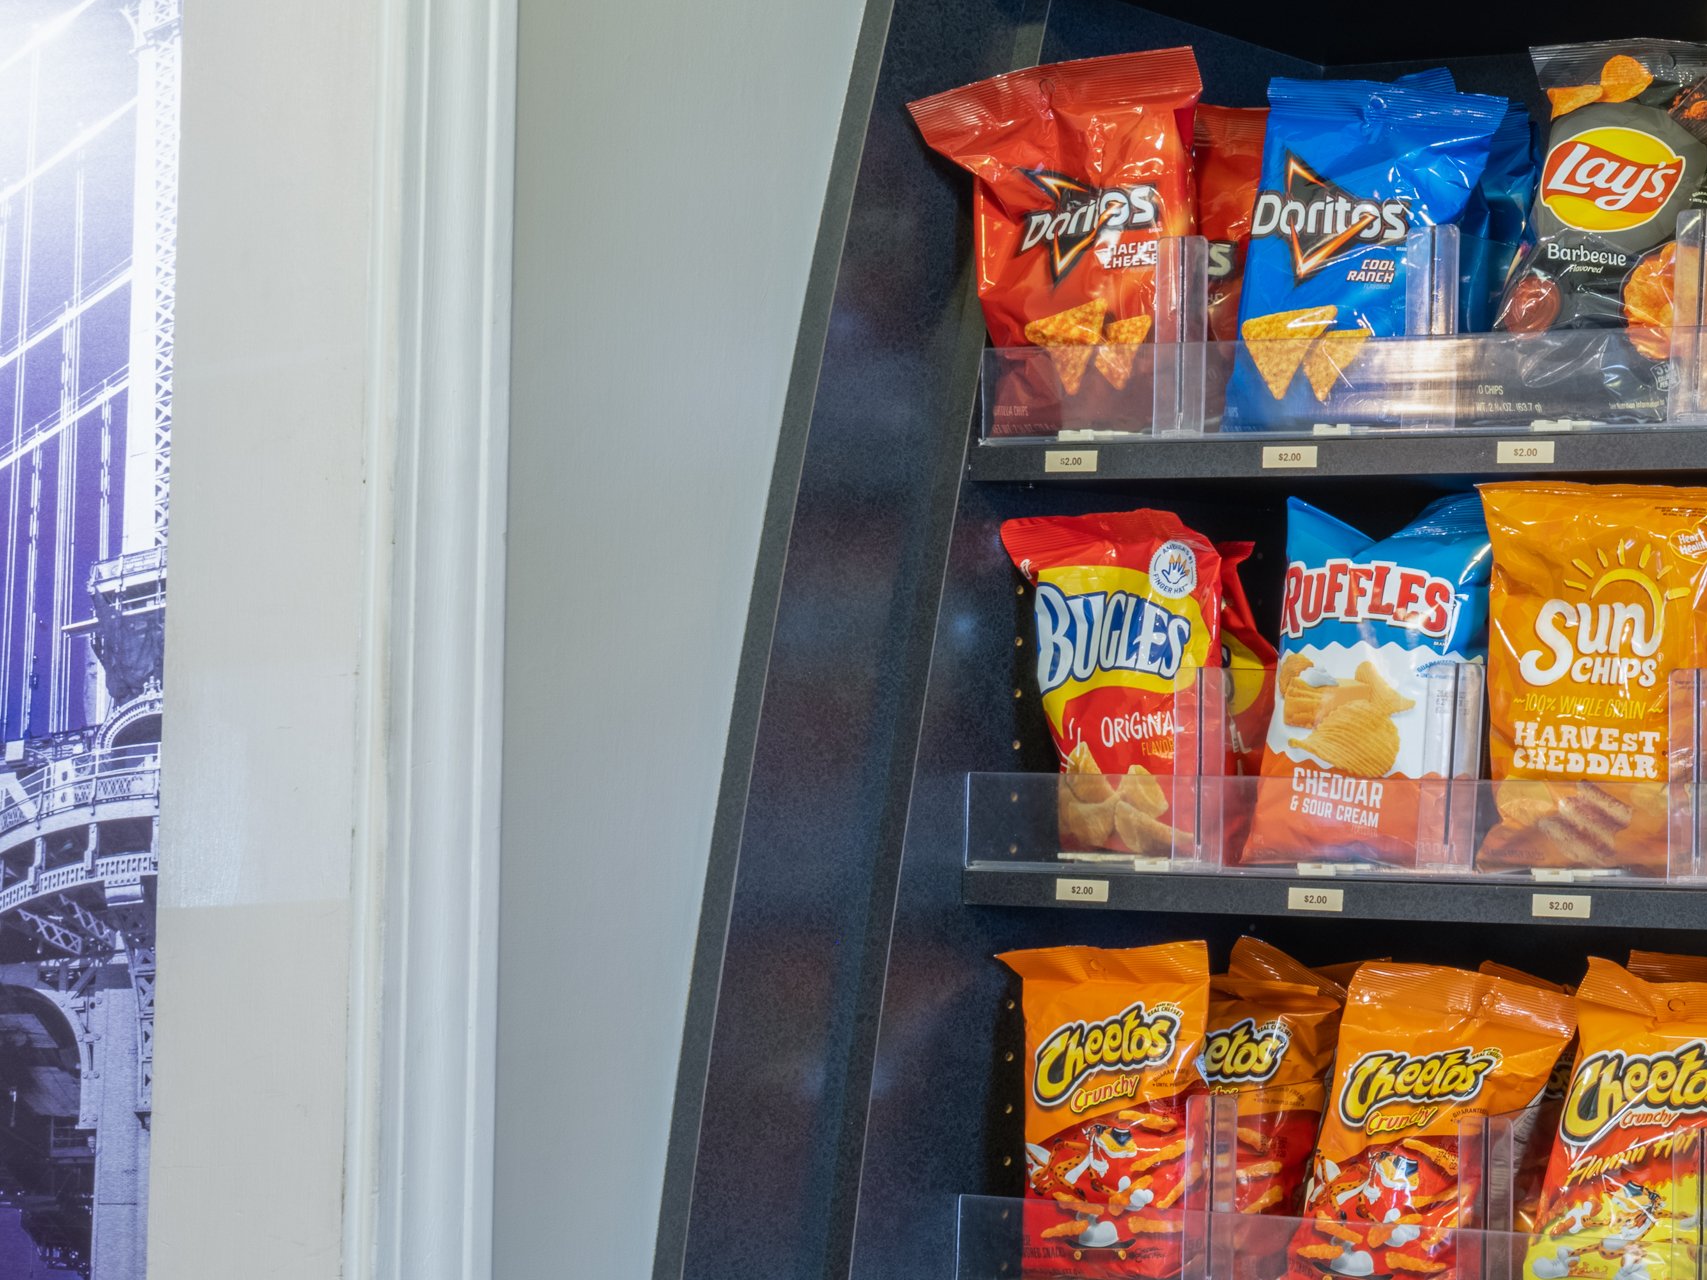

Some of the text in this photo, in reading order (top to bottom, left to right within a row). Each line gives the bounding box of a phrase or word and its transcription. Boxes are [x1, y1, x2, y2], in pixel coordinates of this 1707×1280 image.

[1548, 143, 1676, 211] Lay's
[1022, 186, 1156, 250] Doritos
[1253, 194, 1406, 238] Doritos
[1362, 259, 1395, 271] COOL
[1548, 243, 1626, 266] Barbecue
[1347, 270, 1394, 283] RANCH
[1060, 457, 1082, 466] $2.00
[1281, 560, 1451, 636] RUFFLES
[1036, 584, 1189, 689] BUGLES
[1572, 656, 1656, 687] CHIPS
[1524, 698, 1556, 713] 100%
[1557, 699, 1604, 717] WHOLE
[1514, 749, 1658, 778] CHEDDAR
[1292, 767, 1383, 807] CHEDDAR
[1290, 796, 1379, 827] & SOUR CREAM
[1549, 901, 1573, 910] $2.00
[1037, 1006, 1175, 1101] Cheetos
[1071, 1076, 1139, 1112] Crunchy
